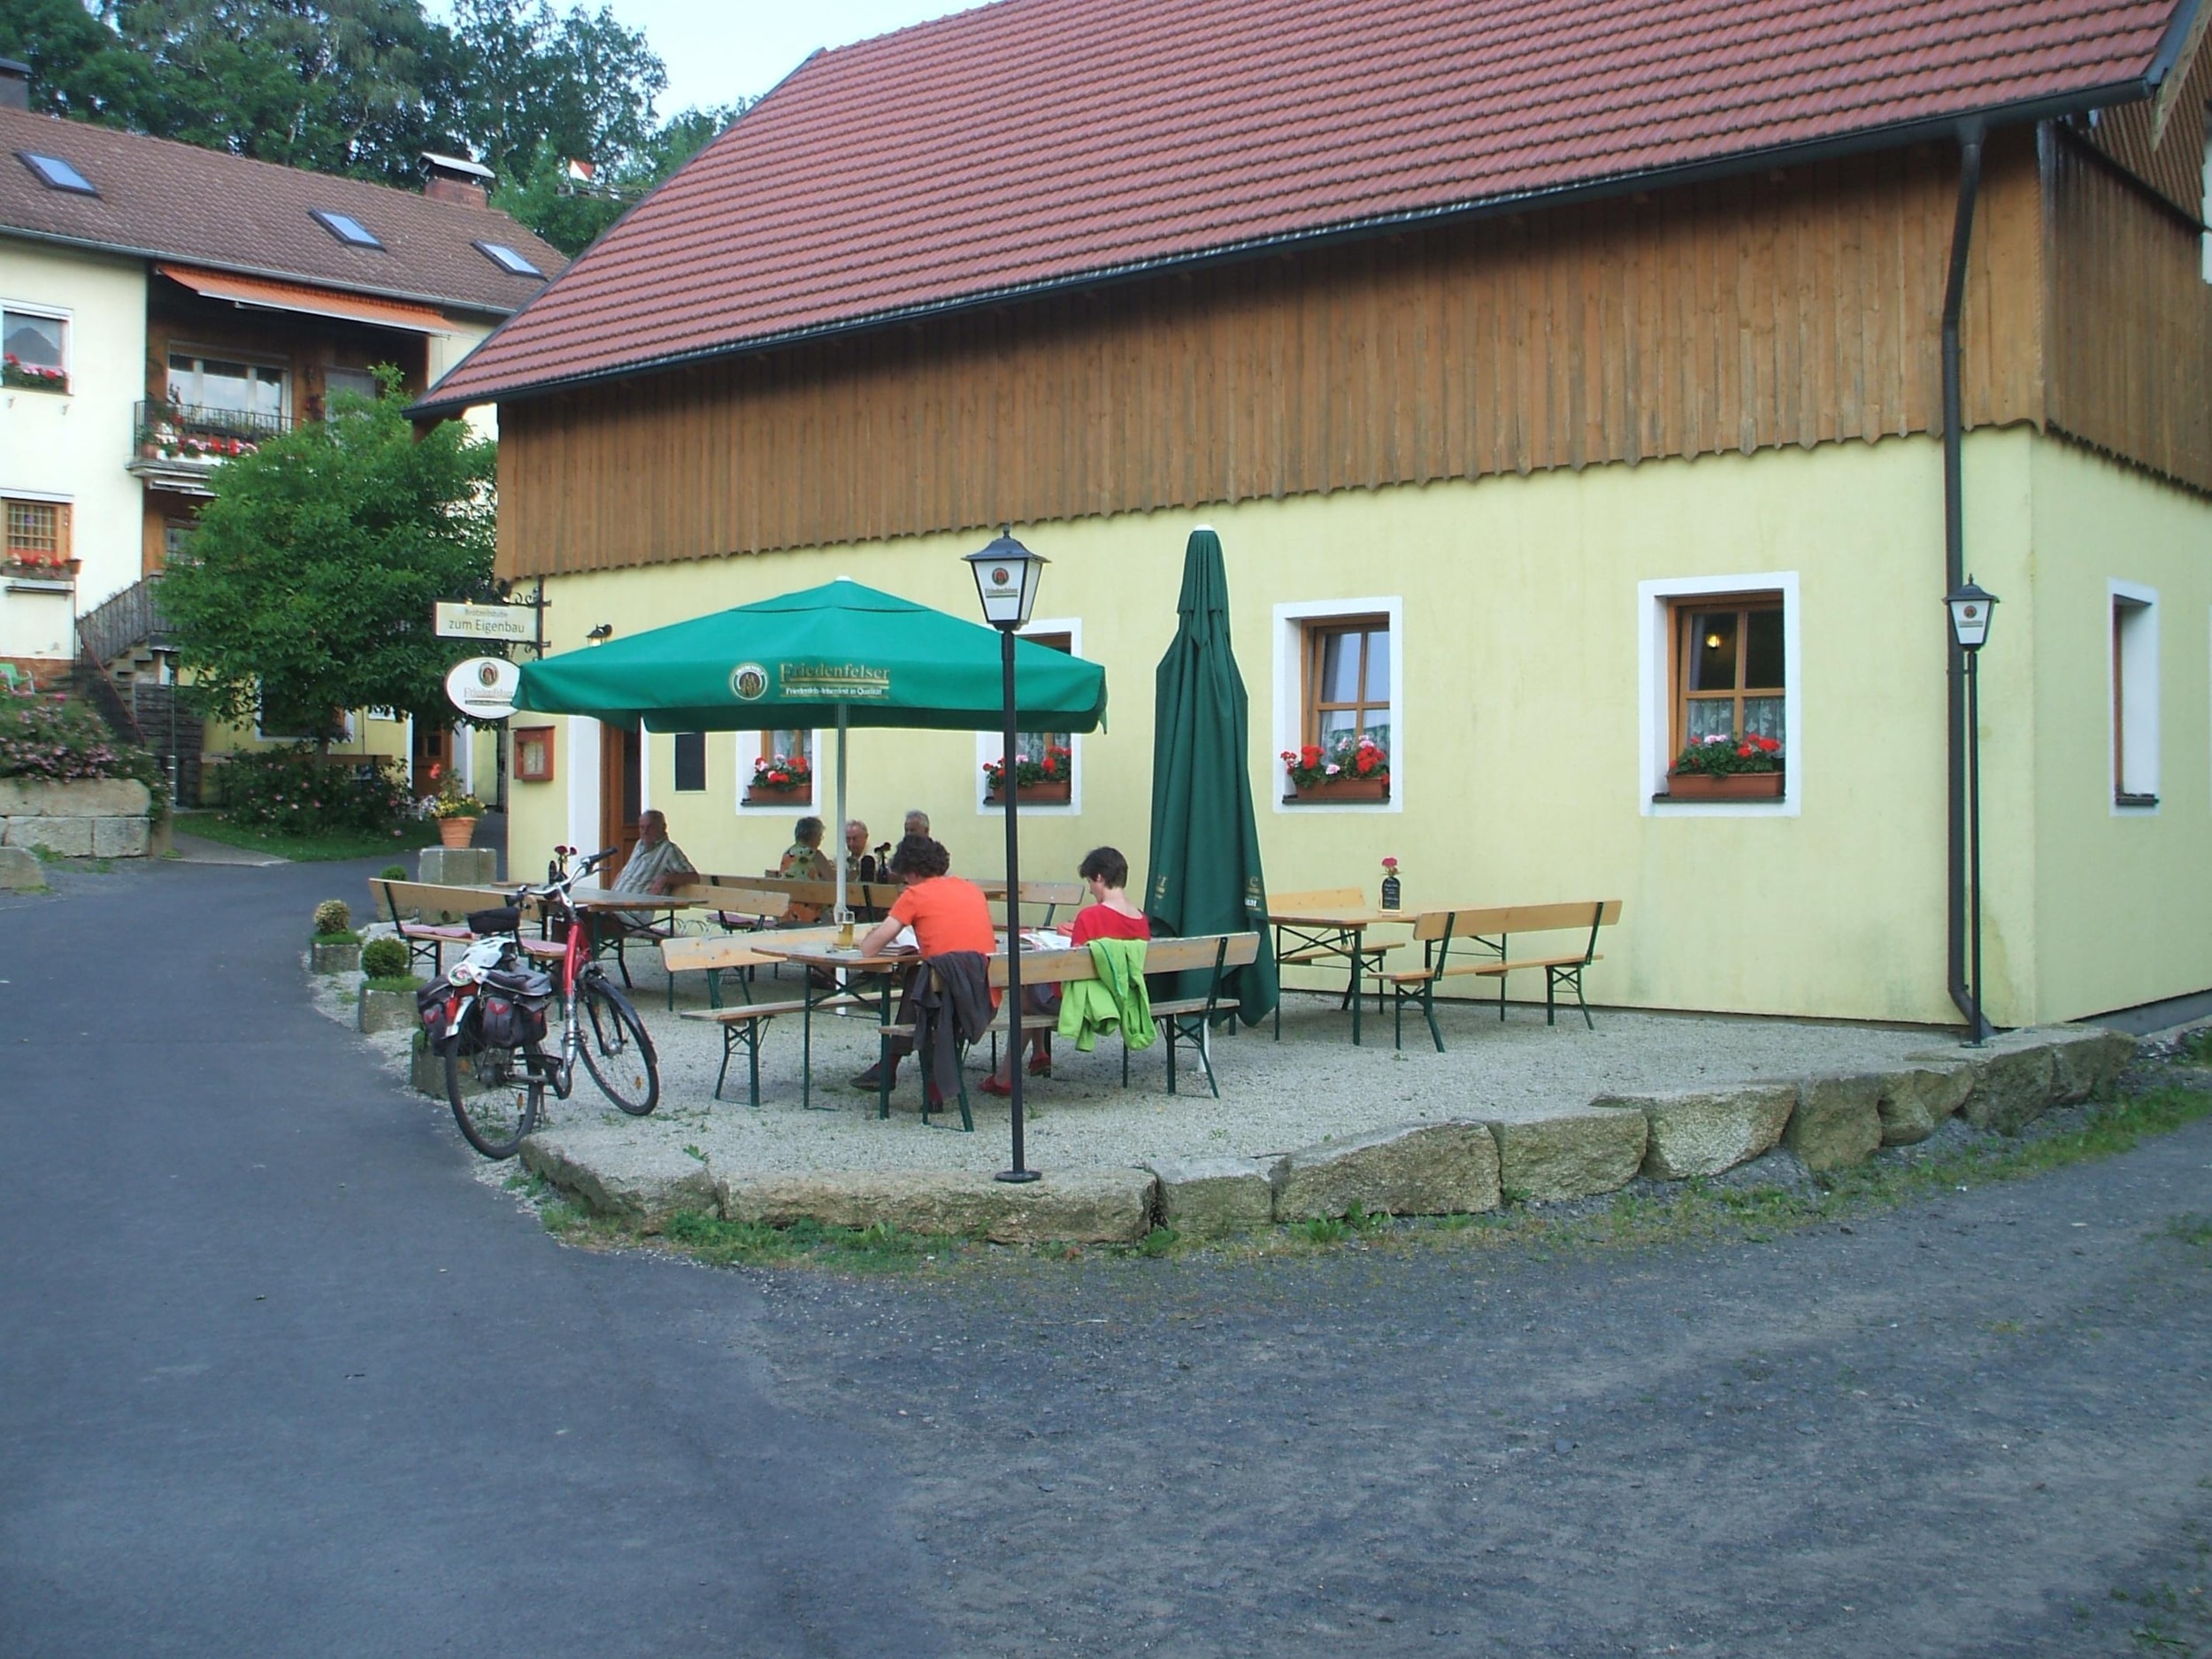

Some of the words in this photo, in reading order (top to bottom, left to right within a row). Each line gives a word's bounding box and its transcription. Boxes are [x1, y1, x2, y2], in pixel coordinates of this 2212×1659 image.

[449, 620, 472, 630] zum
[475, 619, 525, 634] Eigenbau
[780, 663, 889, 682] Friedenfelser
